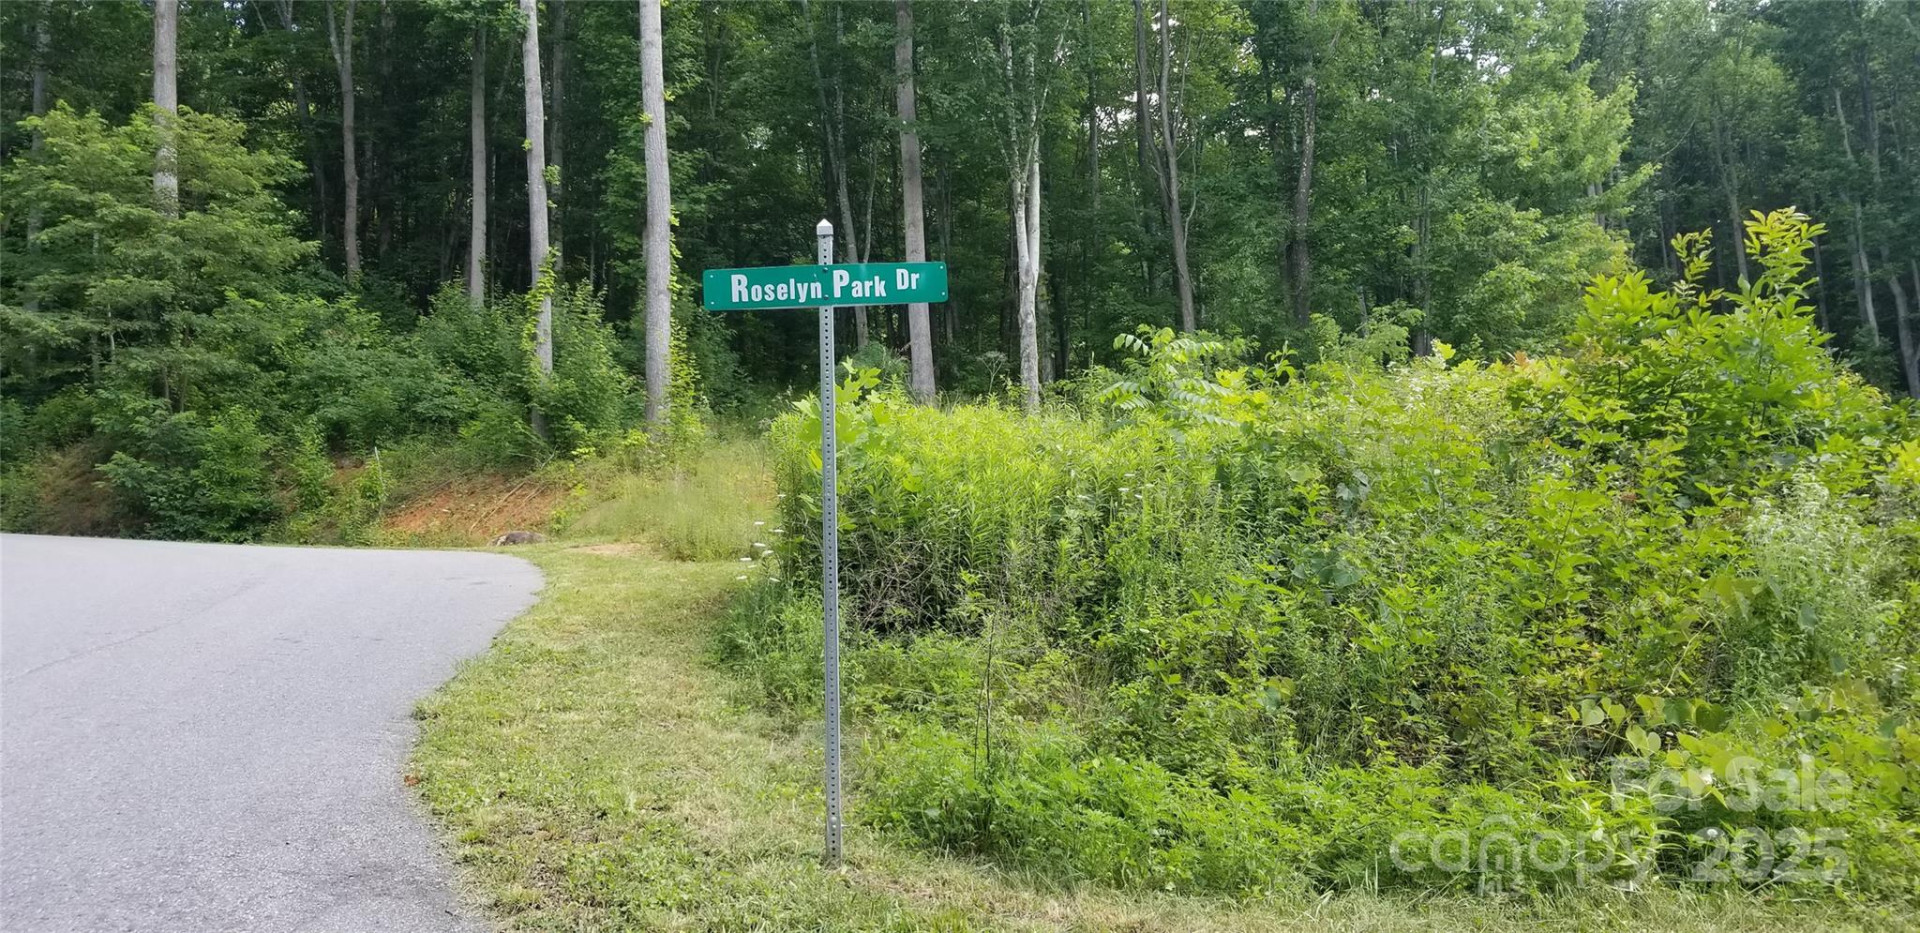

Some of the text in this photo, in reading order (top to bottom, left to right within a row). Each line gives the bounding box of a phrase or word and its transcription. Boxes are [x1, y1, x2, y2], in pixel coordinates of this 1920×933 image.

[731, 268, 920, 303] Roselyn Park Dr
